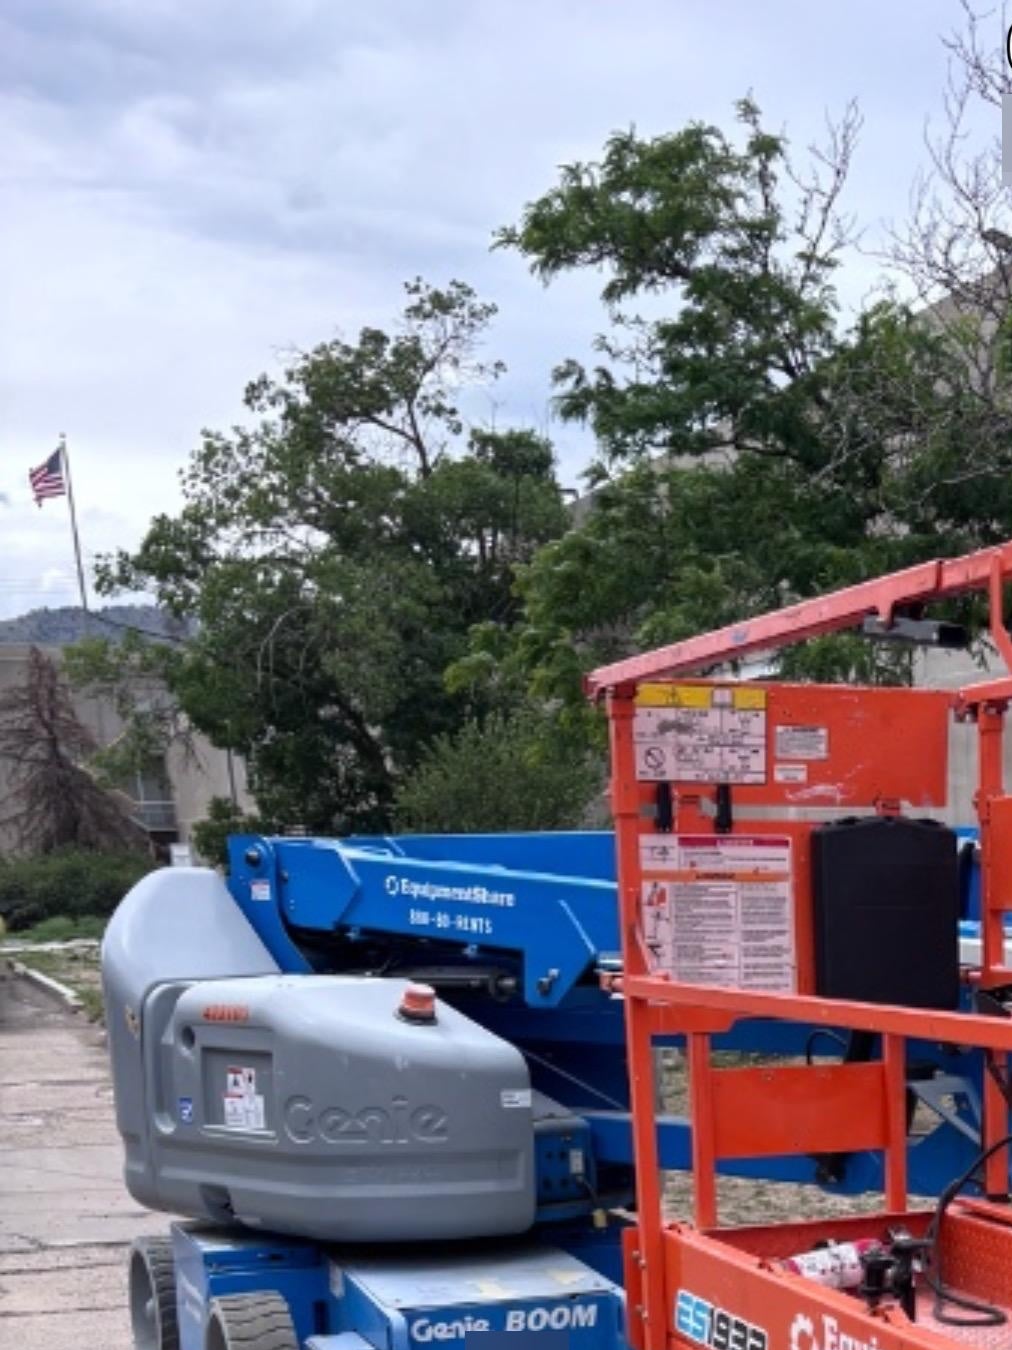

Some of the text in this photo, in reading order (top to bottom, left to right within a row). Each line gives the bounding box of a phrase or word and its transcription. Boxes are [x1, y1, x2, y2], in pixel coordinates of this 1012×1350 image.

[284, 1094, 449, 1144] Genie
[411, 1304, 598, 1342] Genie BOOM
